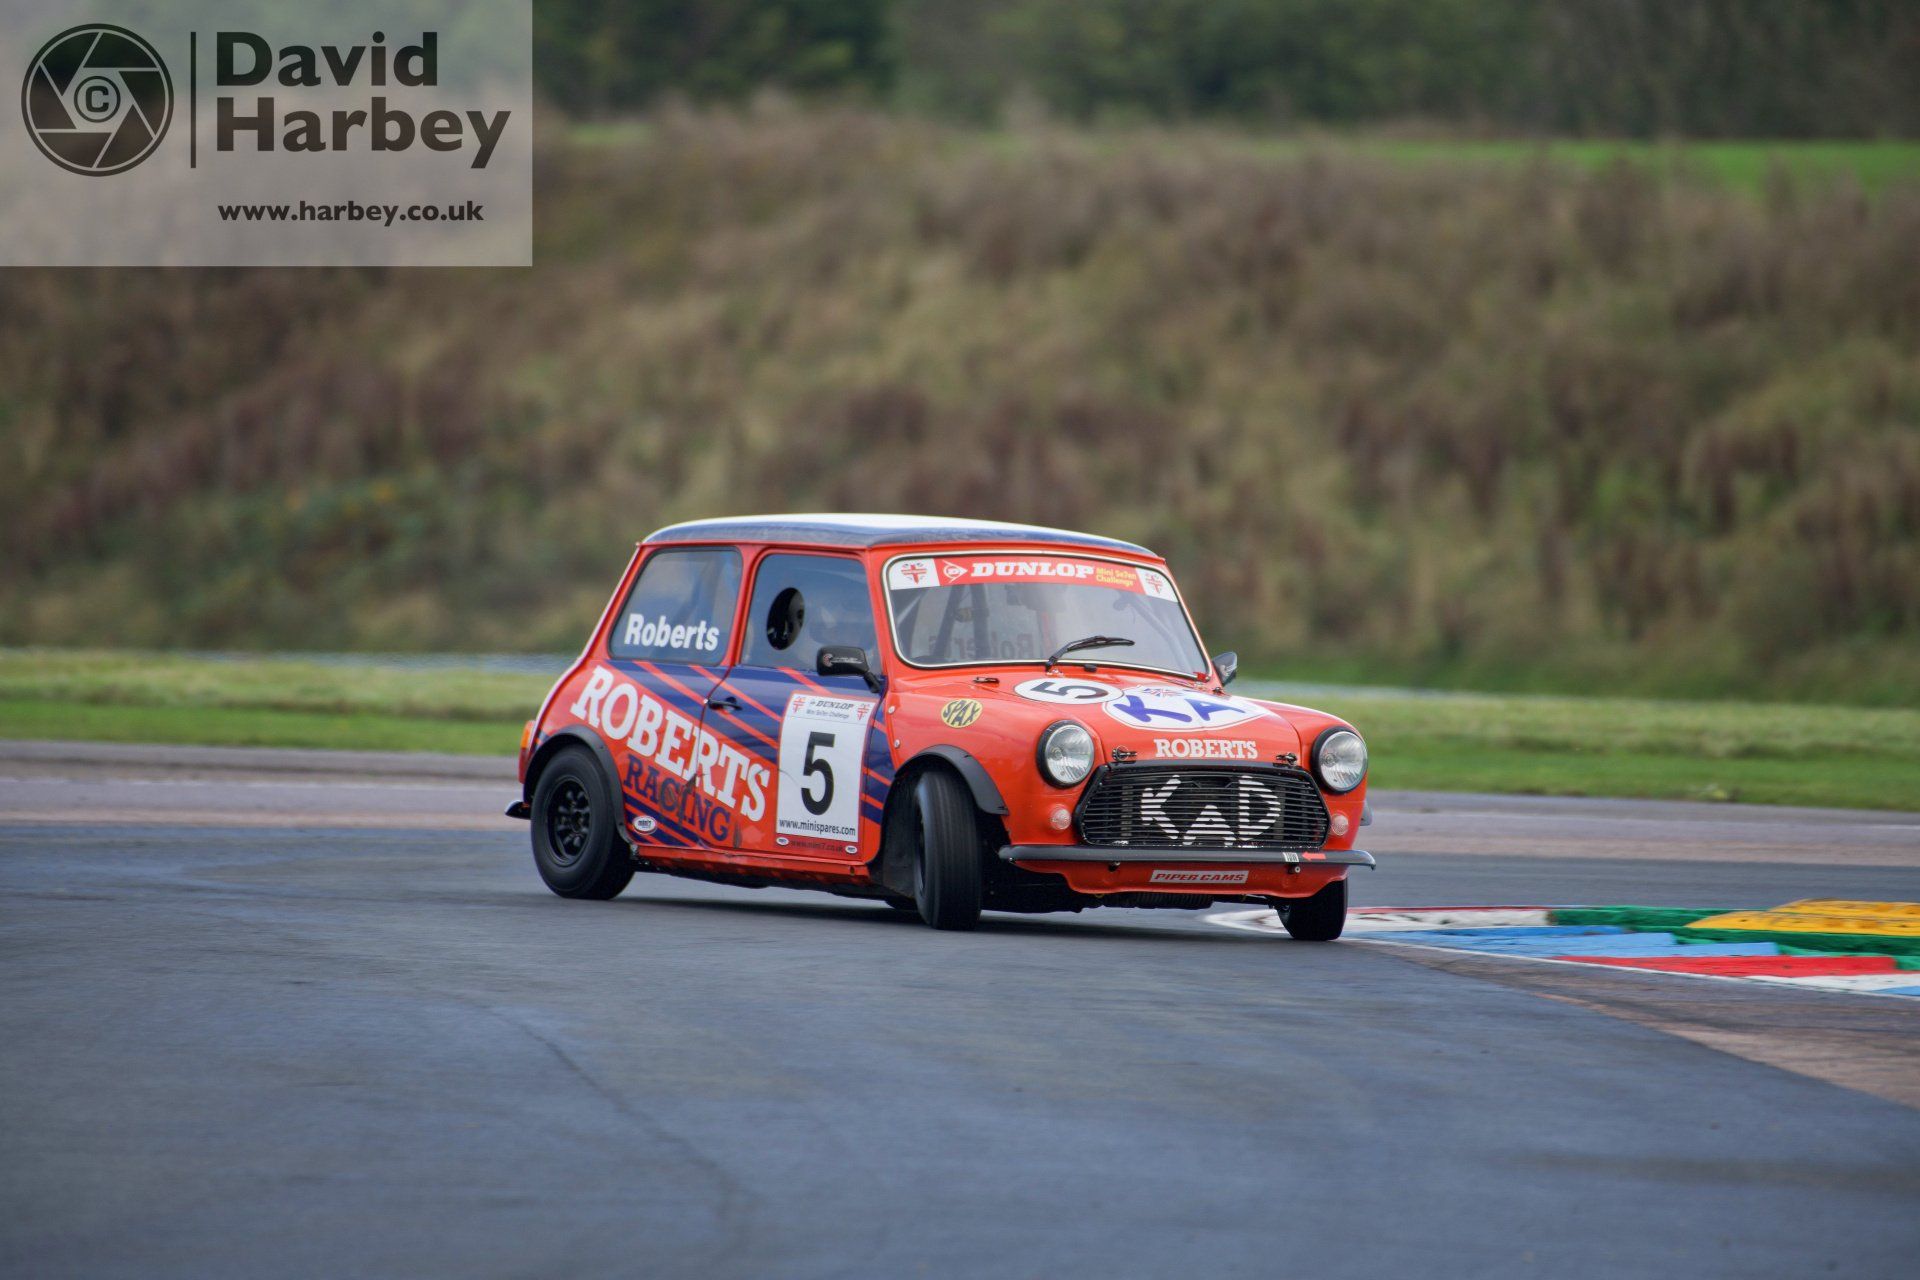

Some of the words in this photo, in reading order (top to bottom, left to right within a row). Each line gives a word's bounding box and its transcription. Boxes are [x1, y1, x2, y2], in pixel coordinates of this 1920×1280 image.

[971, 562, 1095, 578] DUNLOP
[1096, 567, 1114, 577] Mini
[1096, 574, 1134, 587] Challenge
[624, 613, 720, 651] Roberts
[1030, 681, 1108, 699] 5
[816, 700, 854, 710] DUNLOP
[943, 699, 980, 727] SPAX
[570, 665, 771, 822] ROBERTS
[1154, 738, 1258, 759] ROBERTS
[801, 731, 835, 816] 5
[623, 753, 731, 842] RACING
[1141, 774, 1281, 846] KAD
[779, 819, 856, 836] www.minispares.com
[1154, 873, 1200, 881] PIPER
[1200, 873, 1246, 881] CAMS
